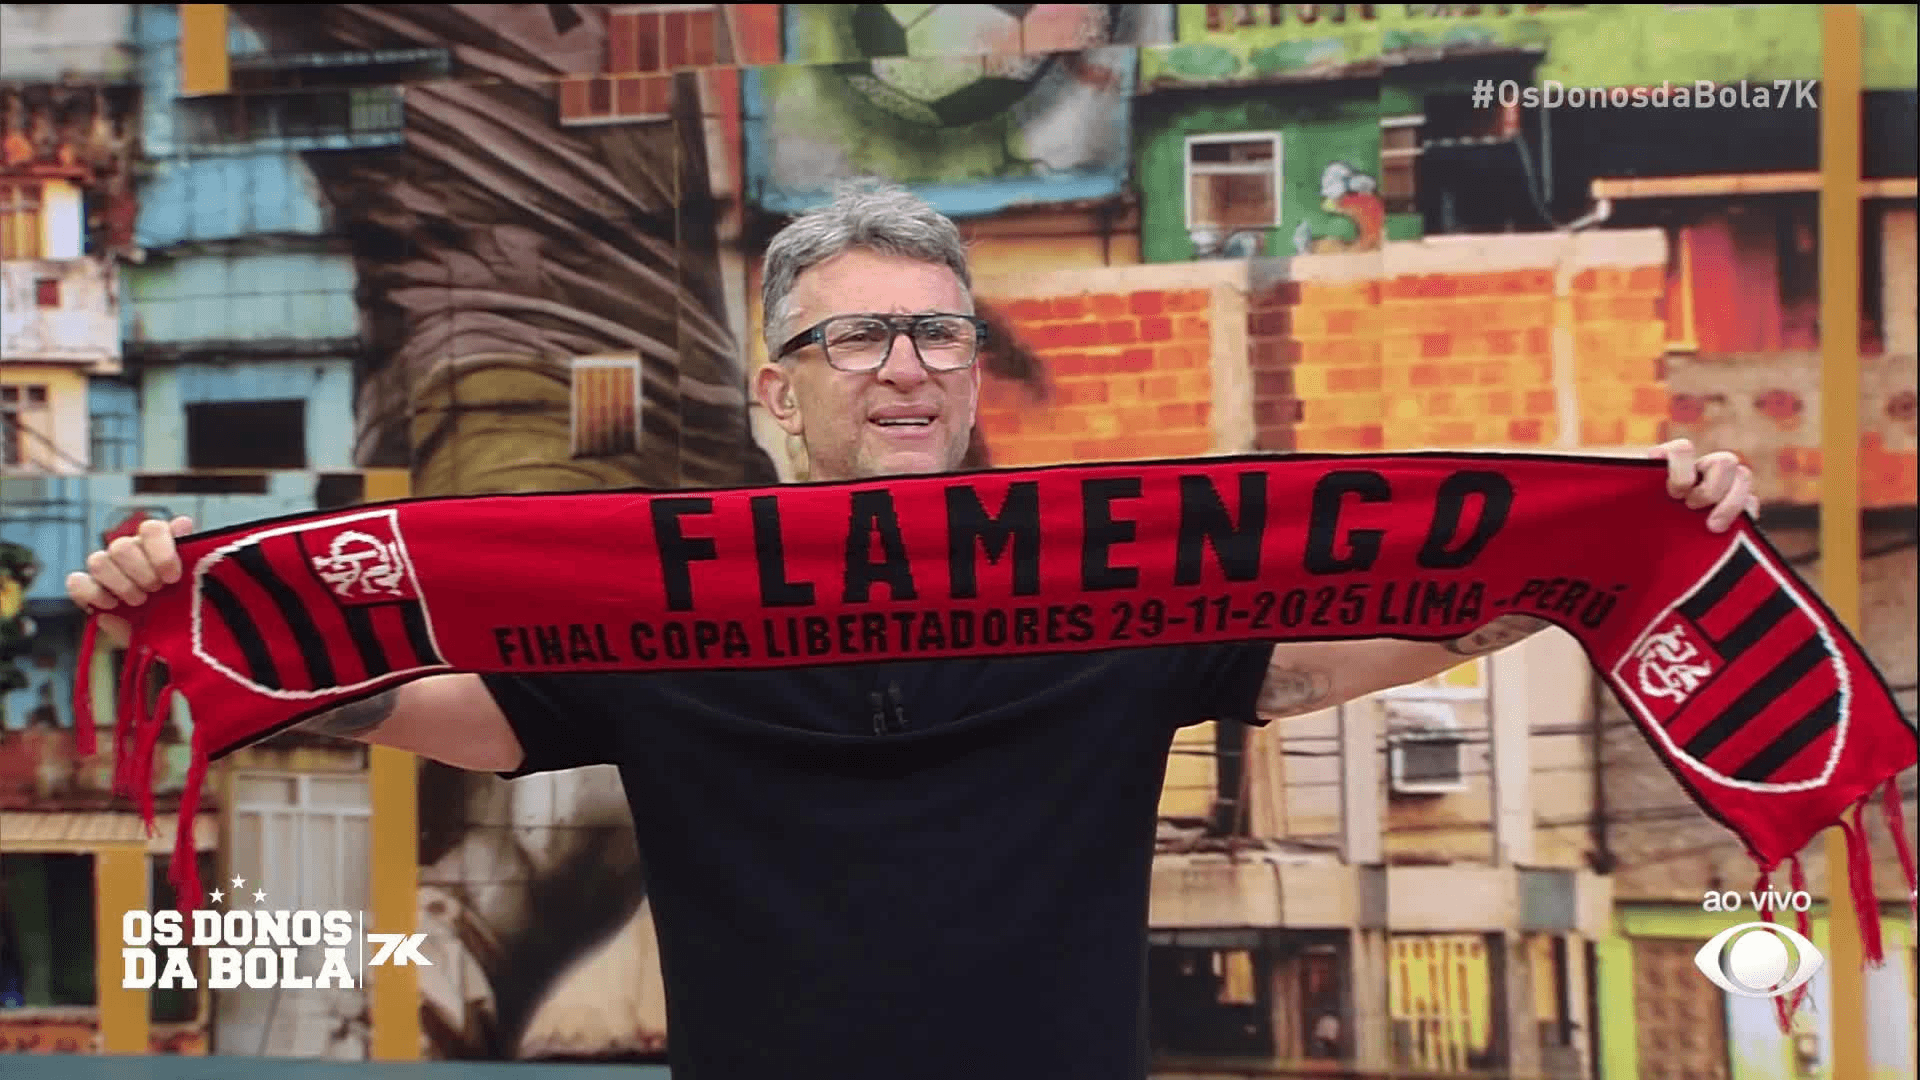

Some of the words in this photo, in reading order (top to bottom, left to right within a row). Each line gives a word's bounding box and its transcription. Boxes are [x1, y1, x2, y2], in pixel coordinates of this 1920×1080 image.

[648, 470, 1515, 611] FLAMENGO
[494, 623, 621, 665] FINAL
[630, 620, 751, 661] COPA
[763, 605, 1095, 657] LIBERTADORES
[1109, 585, 1371, 640] 29-11-2025
[1378, 580, 1487, 625] LIMA
